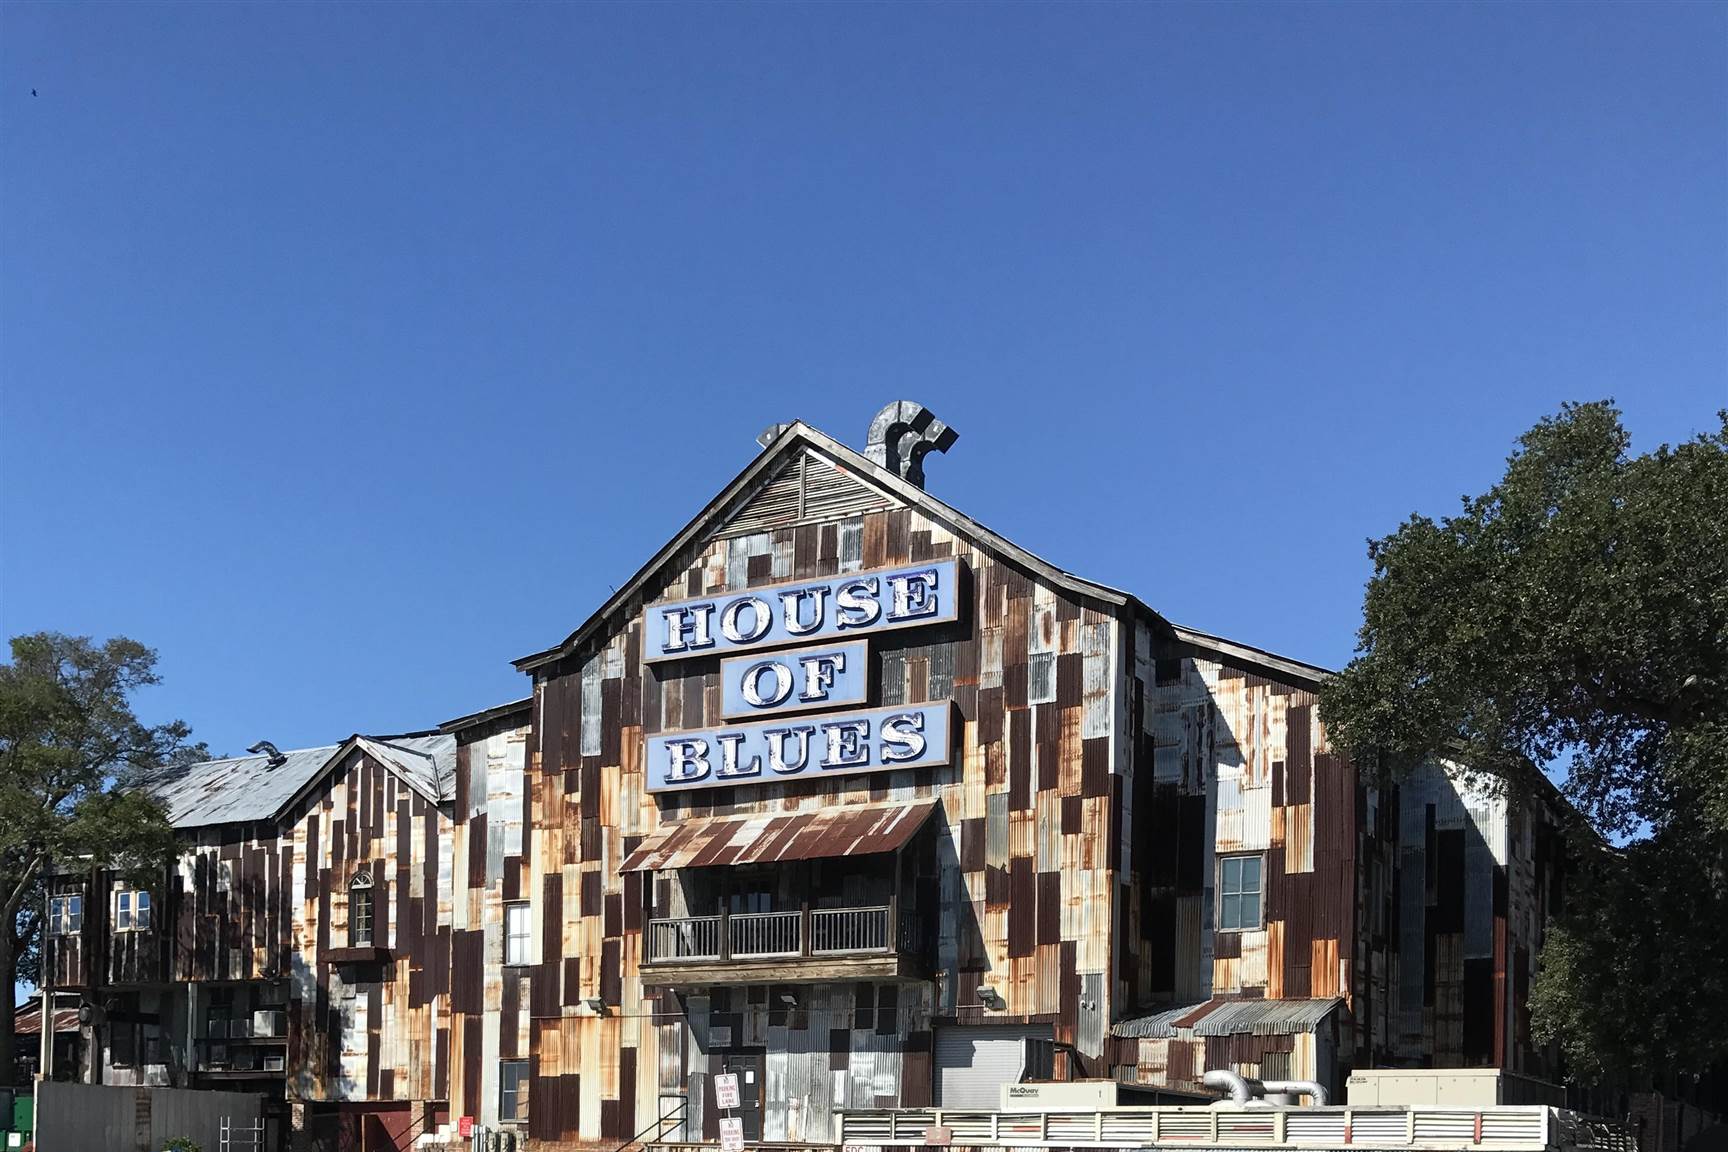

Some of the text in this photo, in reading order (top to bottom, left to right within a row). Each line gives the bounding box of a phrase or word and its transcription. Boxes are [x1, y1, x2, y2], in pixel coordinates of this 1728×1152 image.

[661, 567, 939, 654] HOUSE
[740, 651, 846, 708] OF
[663, 711, 929, 785] BLUES
